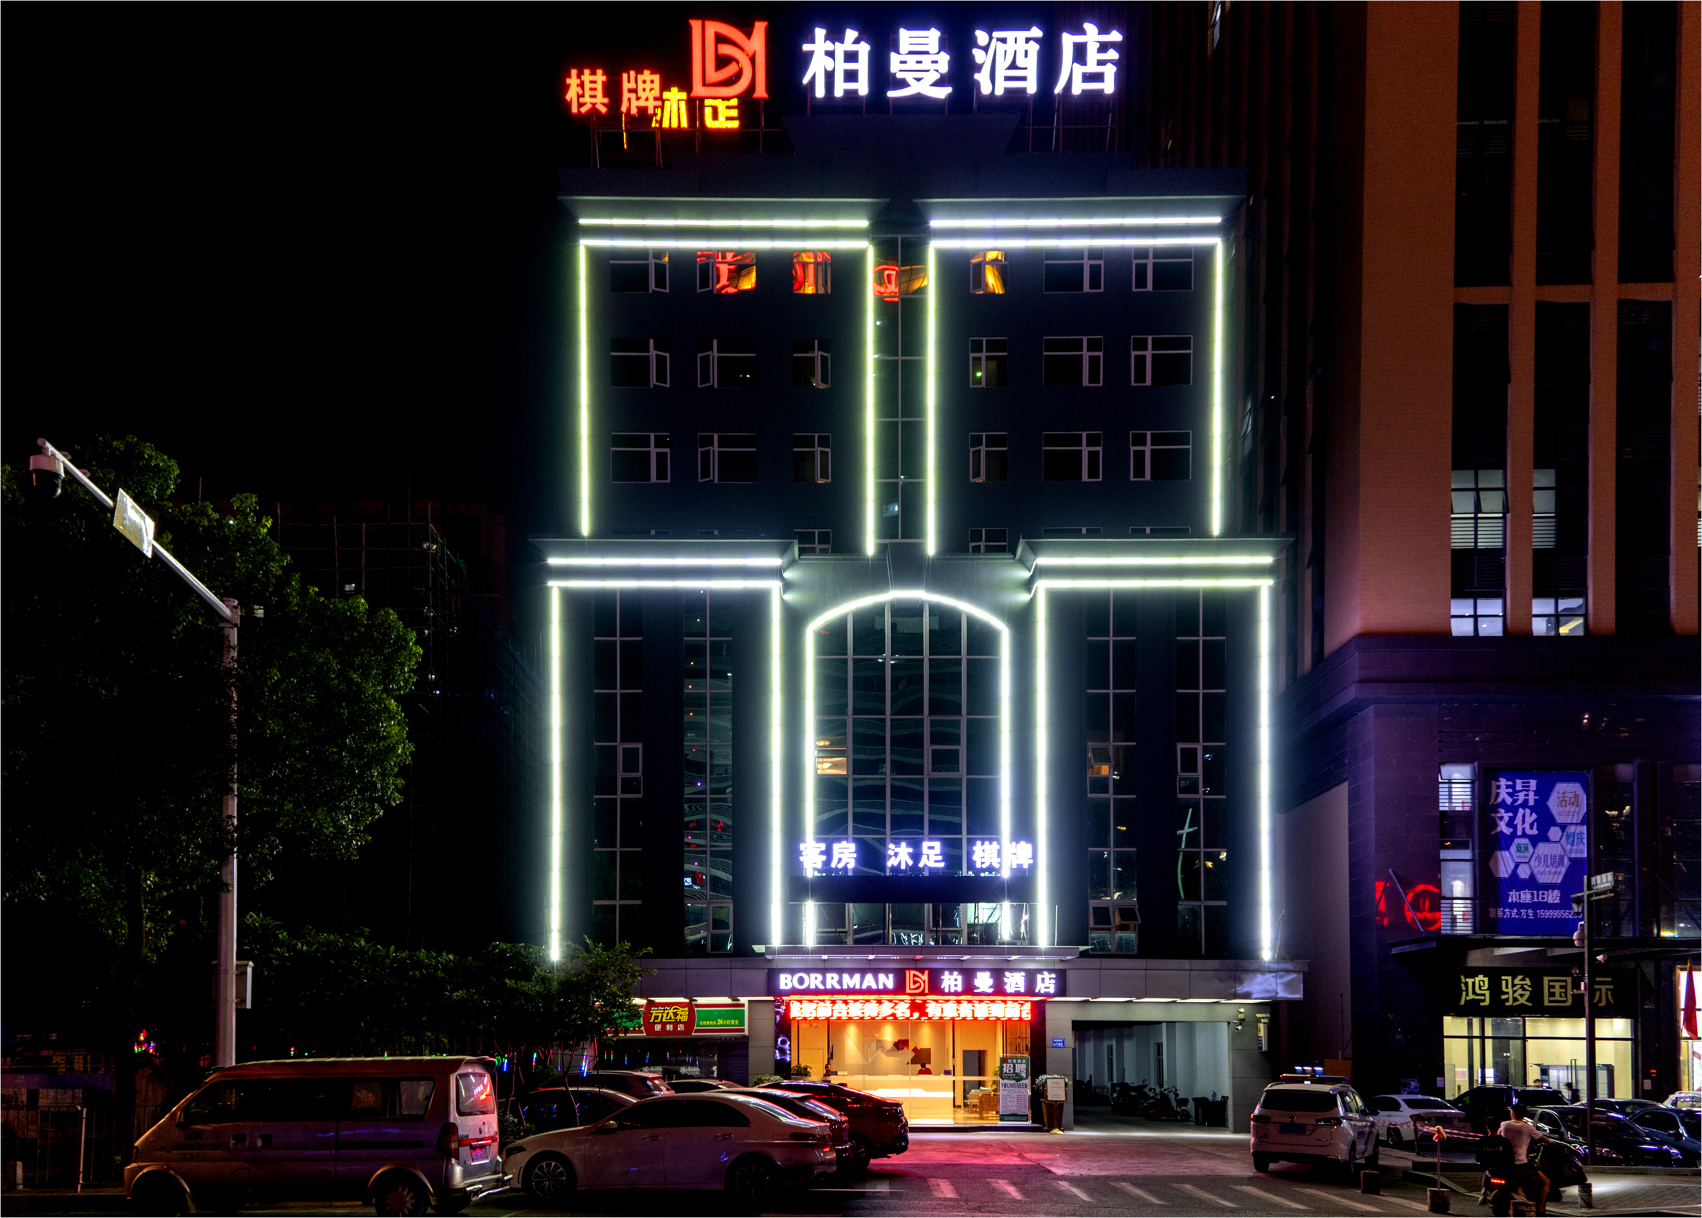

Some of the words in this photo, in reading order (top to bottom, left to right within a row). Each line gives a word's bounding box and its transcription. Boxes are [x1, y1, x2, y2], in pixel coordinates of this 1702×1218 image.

[802, 22, 1123, 99] 柏曼酒店
[565, 69, 662, 114] 棋牌
[1489, 778, 1539, 806] 庆昇
[1556, 790, 1580, 808] 活动
[1490, 807, 1539, 836] 文化
[799, 840, 857, 869] 客房
[886, 841, 945, 870] 沐足
[972, 840, 1034, 869] 棋牌
[1508, 889, 1561, 904] 本座18楼
[779, 973, 894, 990] BORRMAN
[941, 971, 1056, 993] 柏曼酒店
[649, 1006, 689, 1022] 万达福
[1002, 1064, 1026, 1078] 招聘
